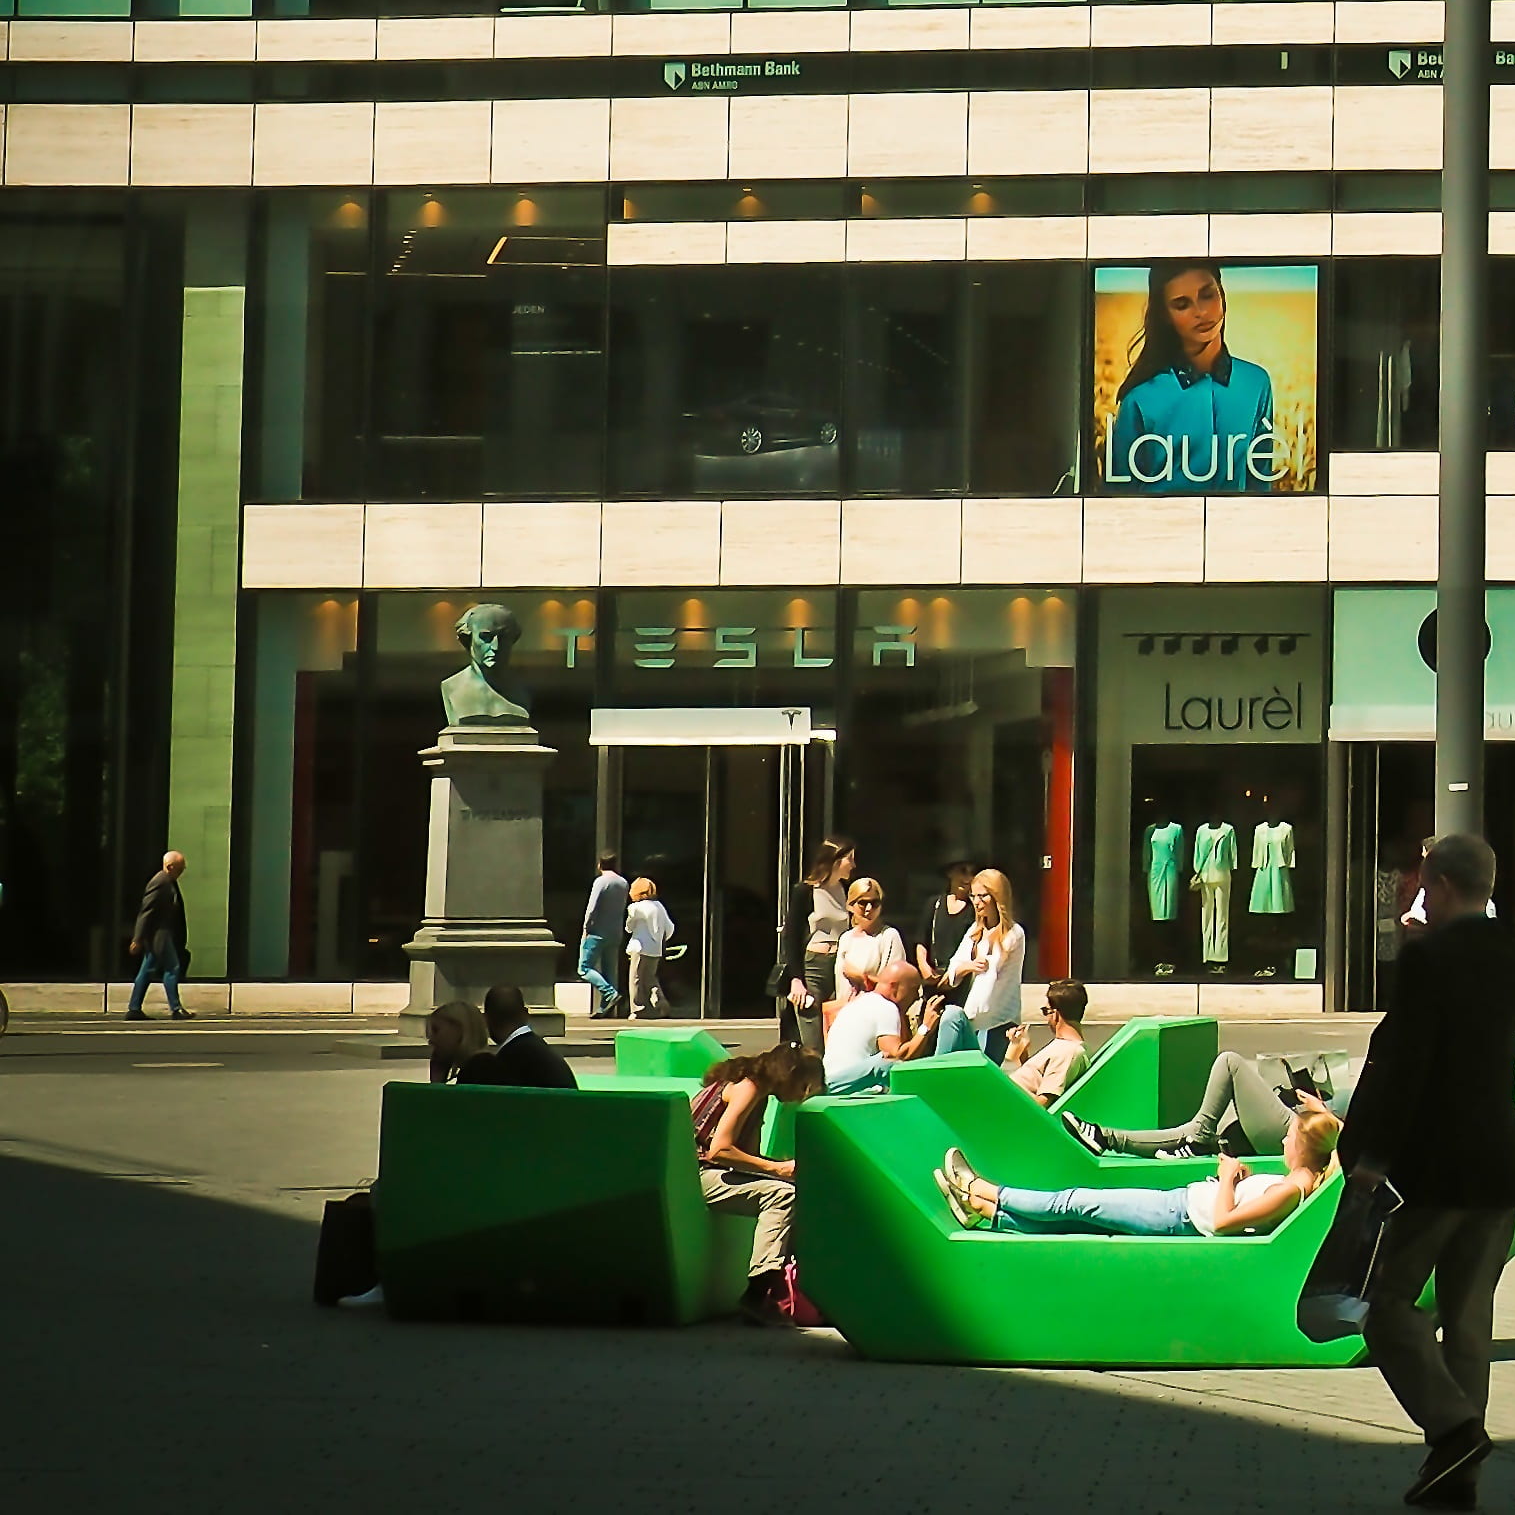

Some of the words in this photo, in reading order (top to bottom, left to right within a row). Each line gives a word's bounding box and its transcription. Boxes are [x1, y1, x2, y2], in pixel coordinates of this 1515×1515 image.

[691, 62, 761, 77] Bethmann
[764, 60, 801, 76] Bank
[1417, 69, 1438, 79] ABN
[691, 81, 710, 90] ABN
[1105, 412, 1305, 483] Laurèl
[552, 627, 918, 668] TESLA
[1164, 681, 1302, 730] Laurèl
